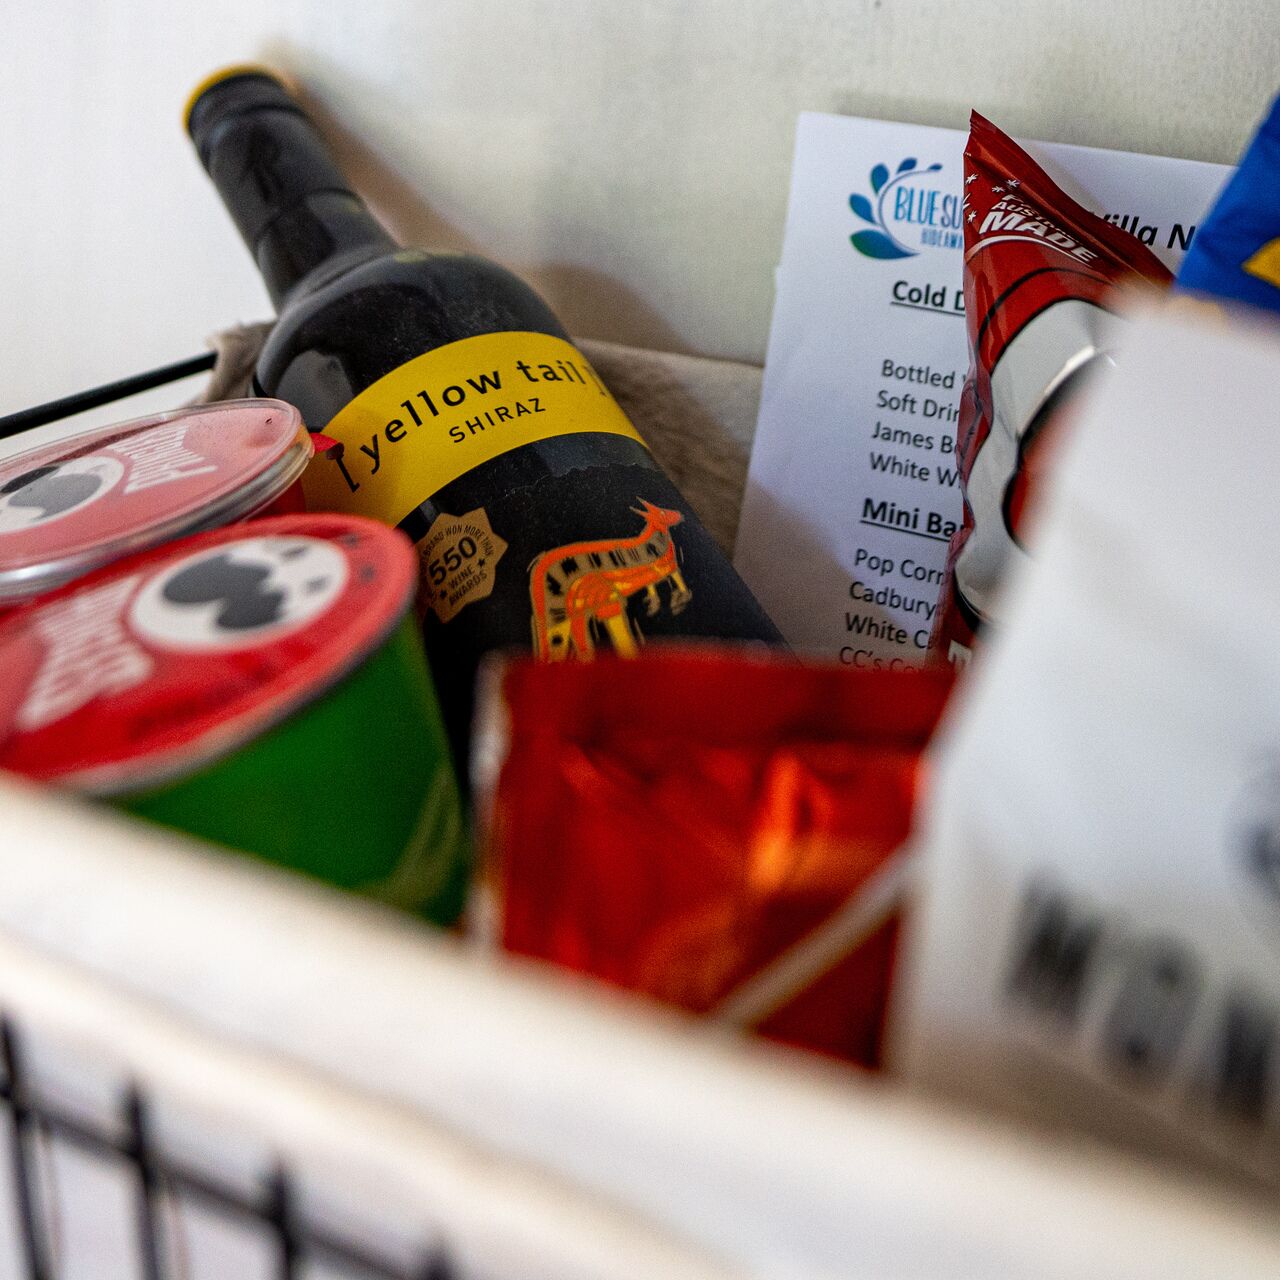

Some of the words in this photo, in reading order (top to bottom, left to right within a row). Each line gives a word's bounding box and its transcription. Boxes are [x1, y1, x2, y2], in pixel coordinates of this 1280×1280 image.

[979, 211, 1099, 262] MADE
[892, 280, 946, 308] Cold
[881, 359, 956, 389] Bottled
[877, 389, 917, 415] Soft
[449, 397, 546, 443] SHIRAZ
[871, 421, 934, 450] James
[870, 451, 930, 481] White
[862, 497, 920, 529] Mini
[445, 524, 462, 536] WON
[463, 525, 486, 540] MORE
[428, 536, 478, 586] 550
[854, 548, 894, 576] Pop
[448, 564, 476, 589] WINE
[448, 571, 488, 606] AWARDS
[849, 581, 937, 620] Cadbury
[845, 612, 908, 644] White
